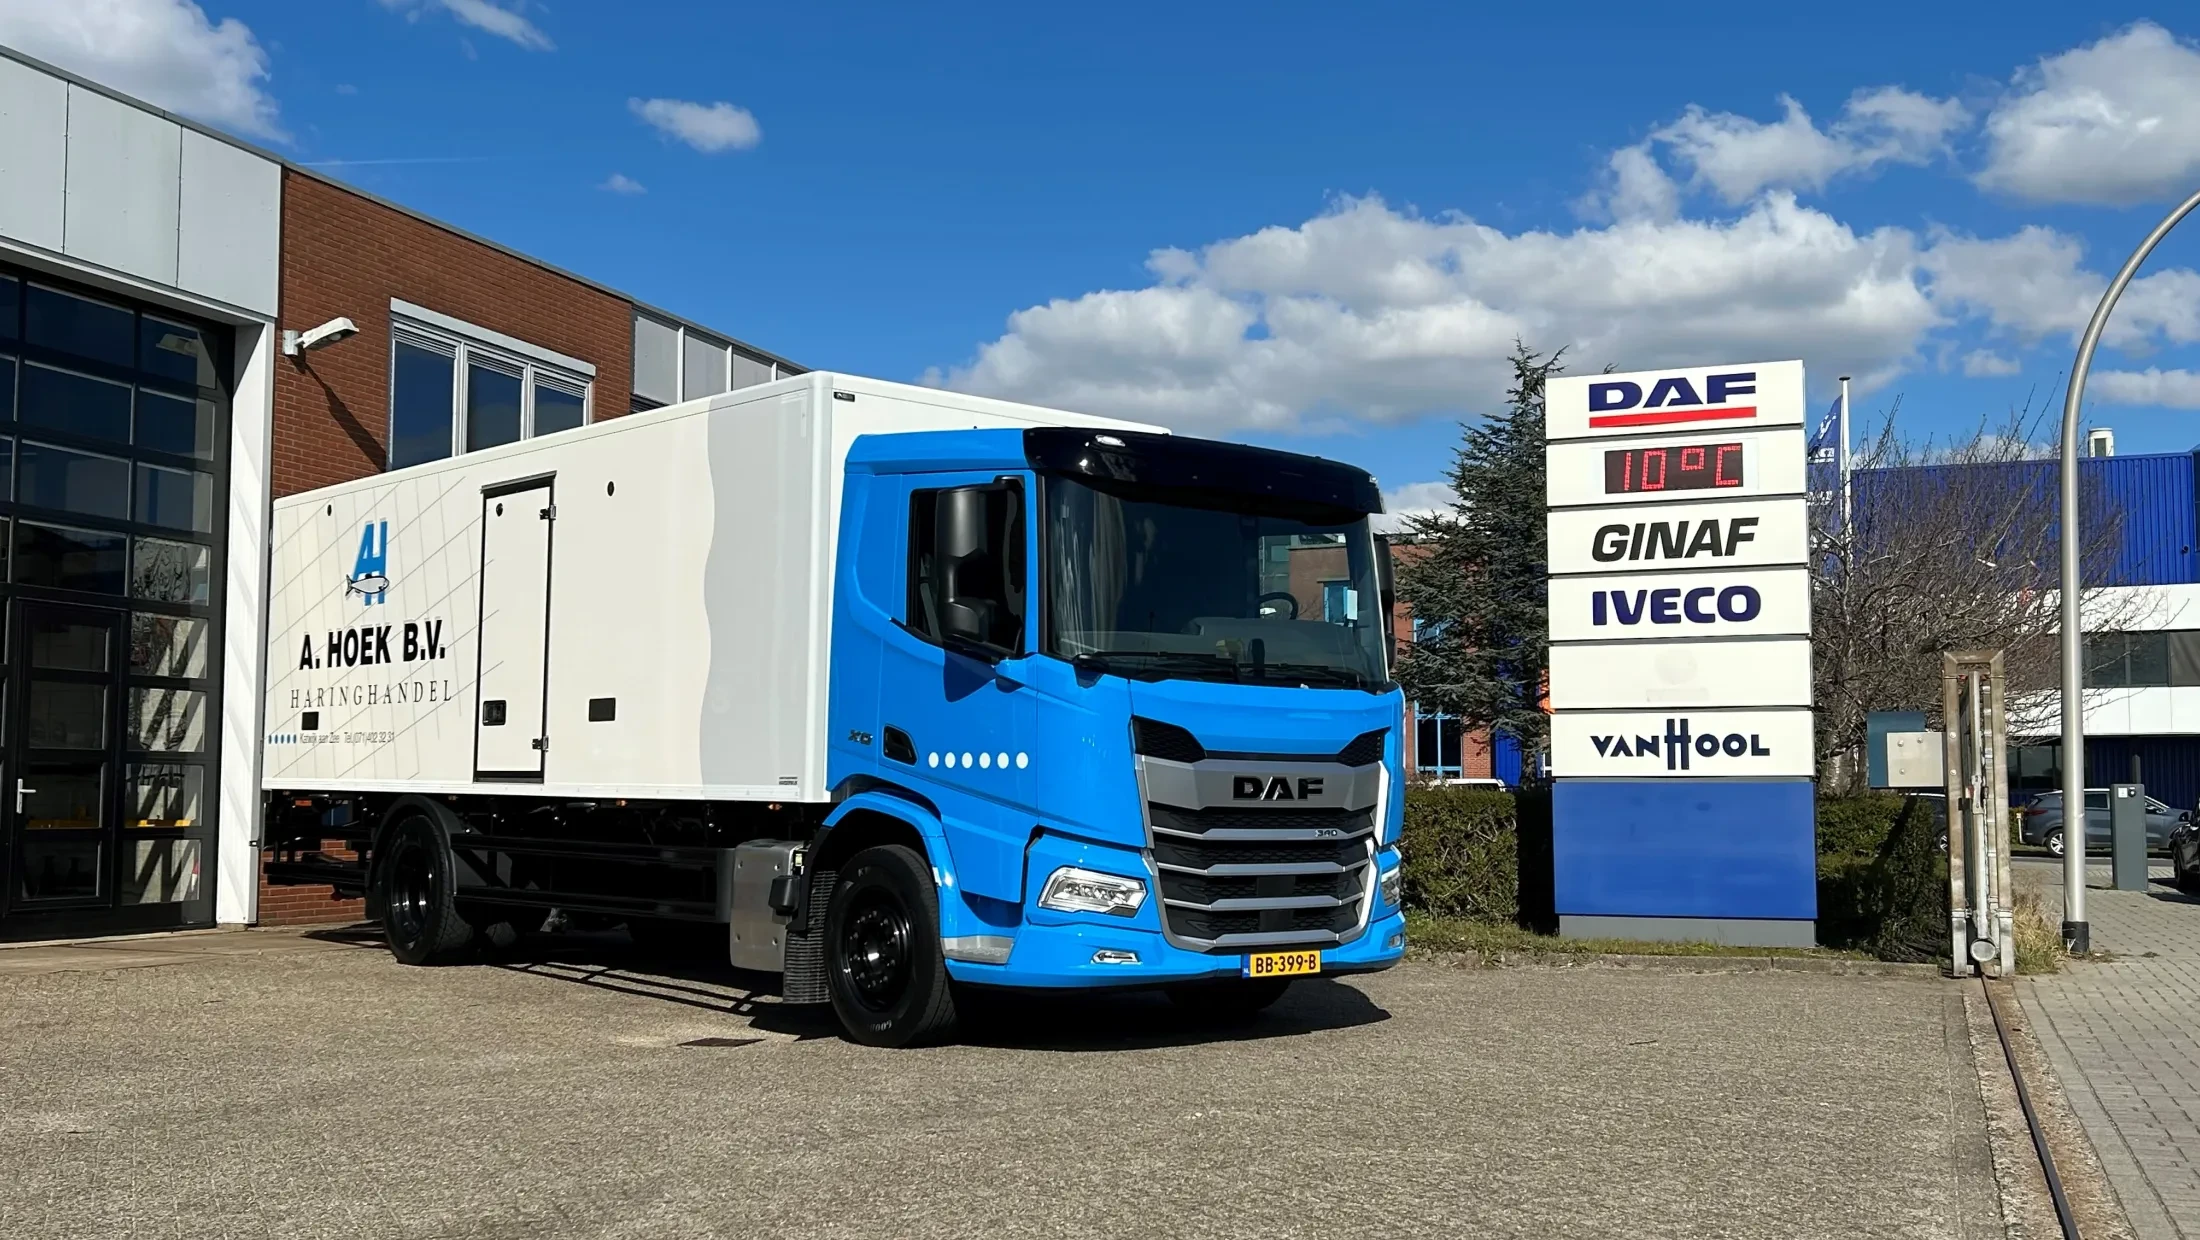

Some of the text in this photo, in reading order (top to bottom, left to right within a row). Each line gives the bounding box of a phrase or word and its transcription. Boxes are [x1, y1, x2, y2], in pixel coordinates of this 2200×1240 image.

[1589, 372, 1757, 412] DAF
[1591, 516, 1760, 562] GINAF
[1592, 585, 1762, 626] IVECO
[299, 619, 446, 671] A. HOEK B.V.
[290, 679, 452, 709] HARINGHANDEL
[1232, 775, 1324, 801] DAF
[1256, 954, 1316, 974] BB-399-B
